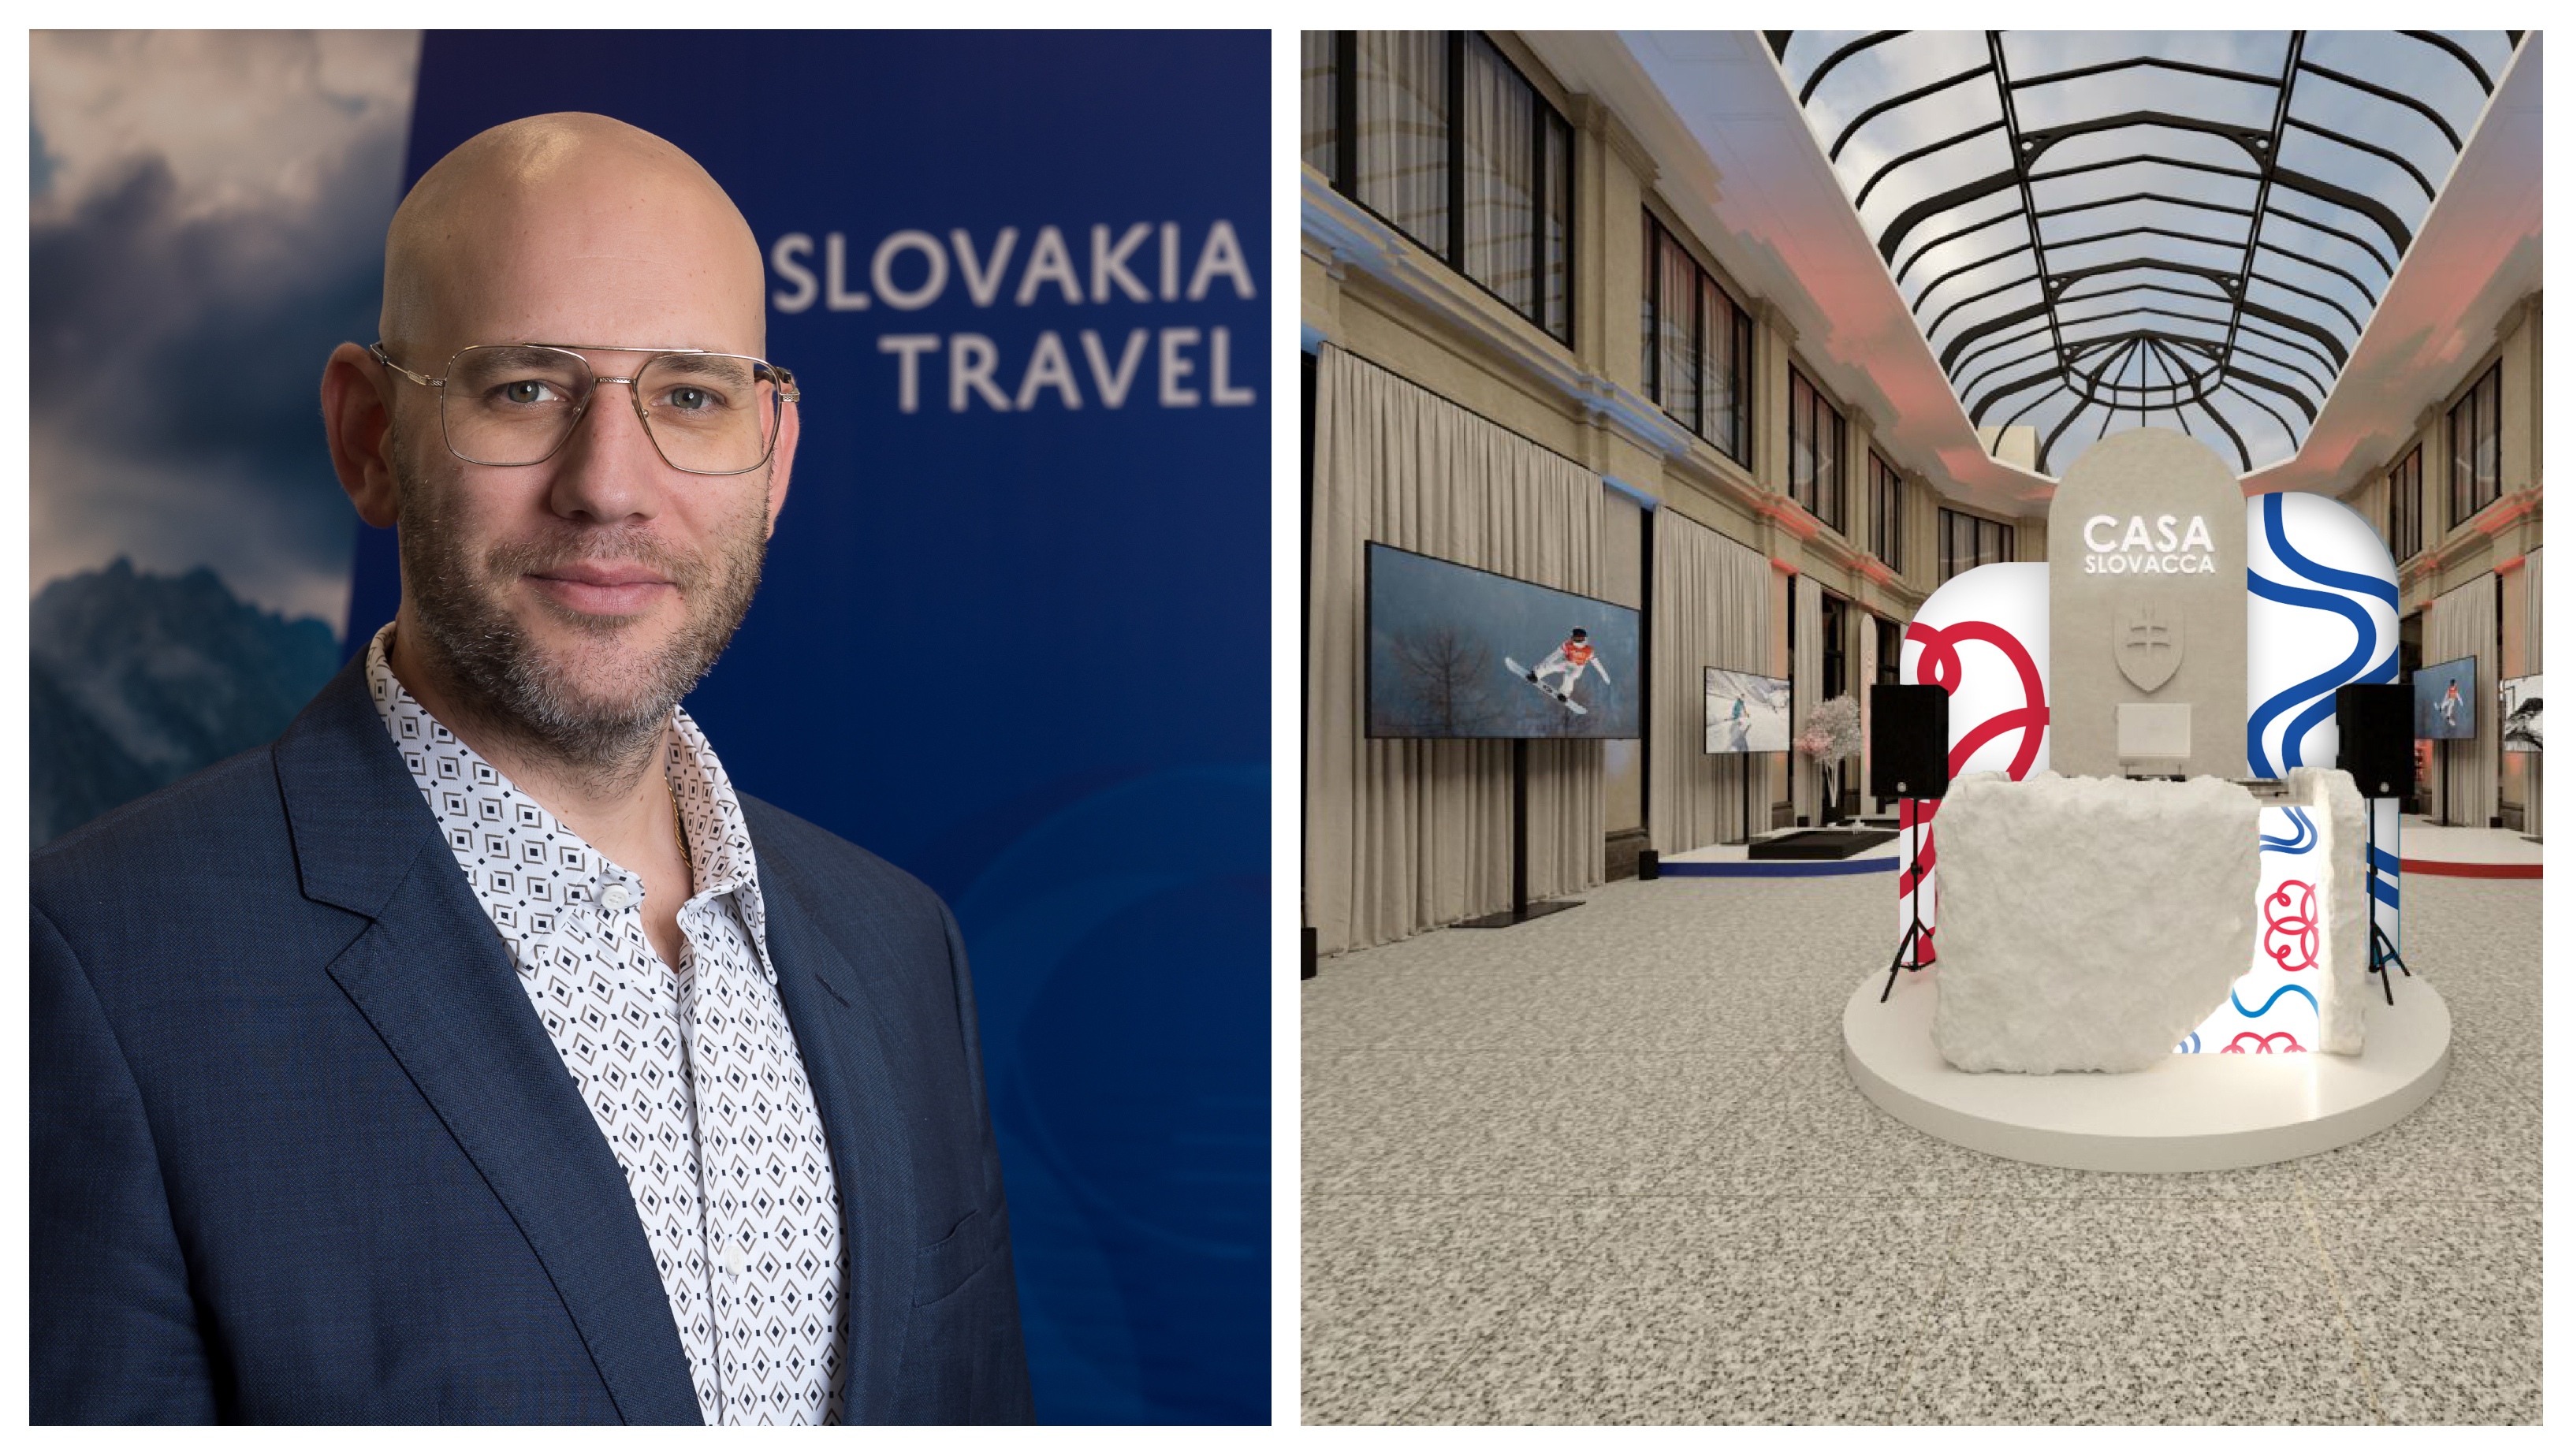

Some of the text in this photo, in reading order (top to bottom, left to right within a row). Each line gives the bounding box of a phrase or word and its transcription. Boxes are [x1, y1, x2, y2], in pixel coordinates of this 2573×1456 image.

[771, 219, 1257, 314] SLOVAKIA
[877, 326, 1257, 415] TRAVEL
[2083, 515, 2215, 553] CASA
[2083, 554, 2216, 574] SLOVACCA
